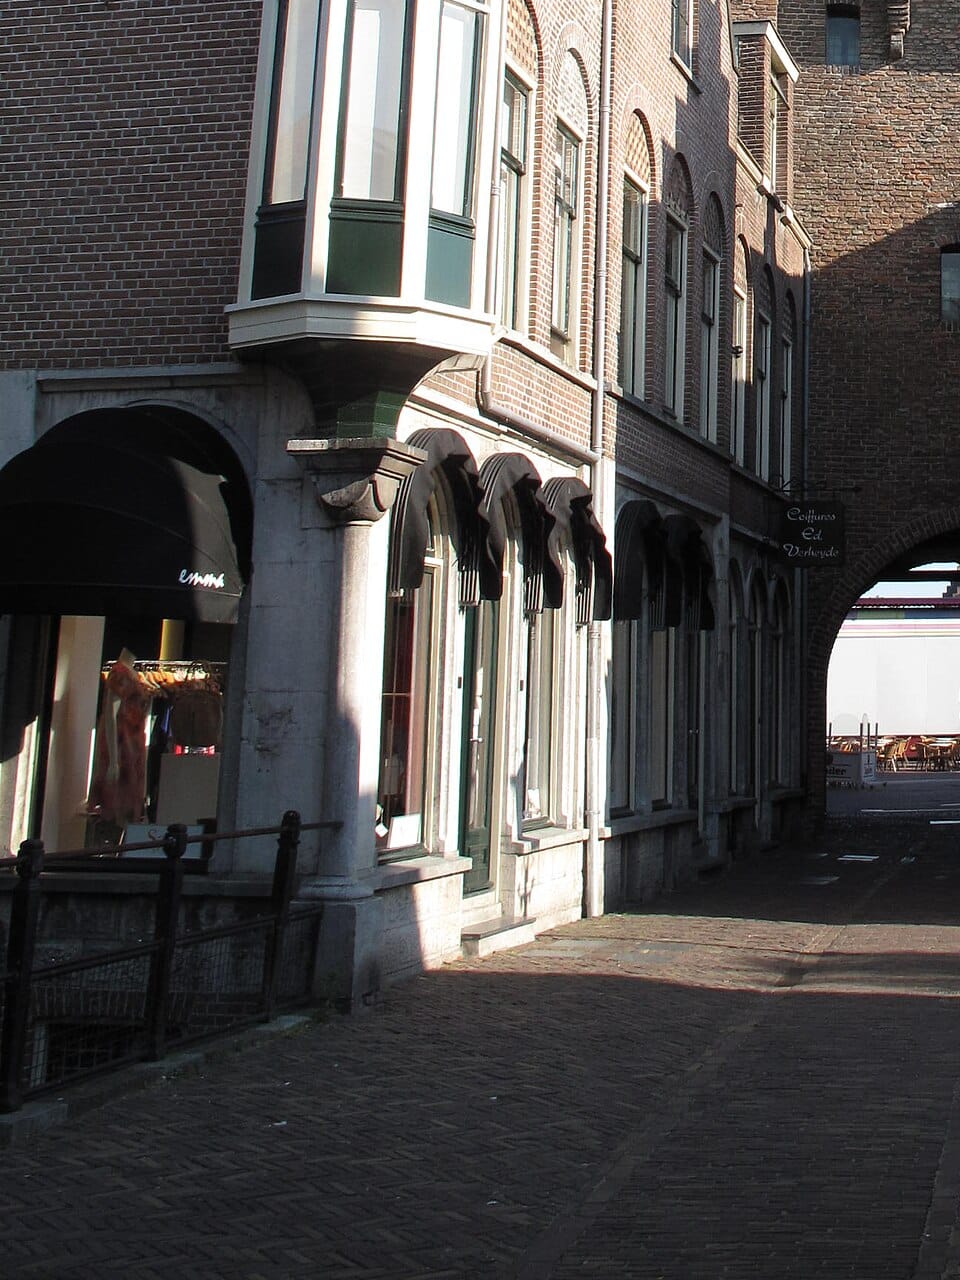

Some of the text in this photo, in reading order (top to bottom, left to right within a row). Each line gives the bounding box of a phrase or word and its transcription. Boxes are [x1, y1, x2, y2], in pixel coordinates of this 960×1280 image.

[786, 507, 837, 523] Coiffures
[782, 543, 839, 559] Verheyde
[178, 568, 225, 589] emma
